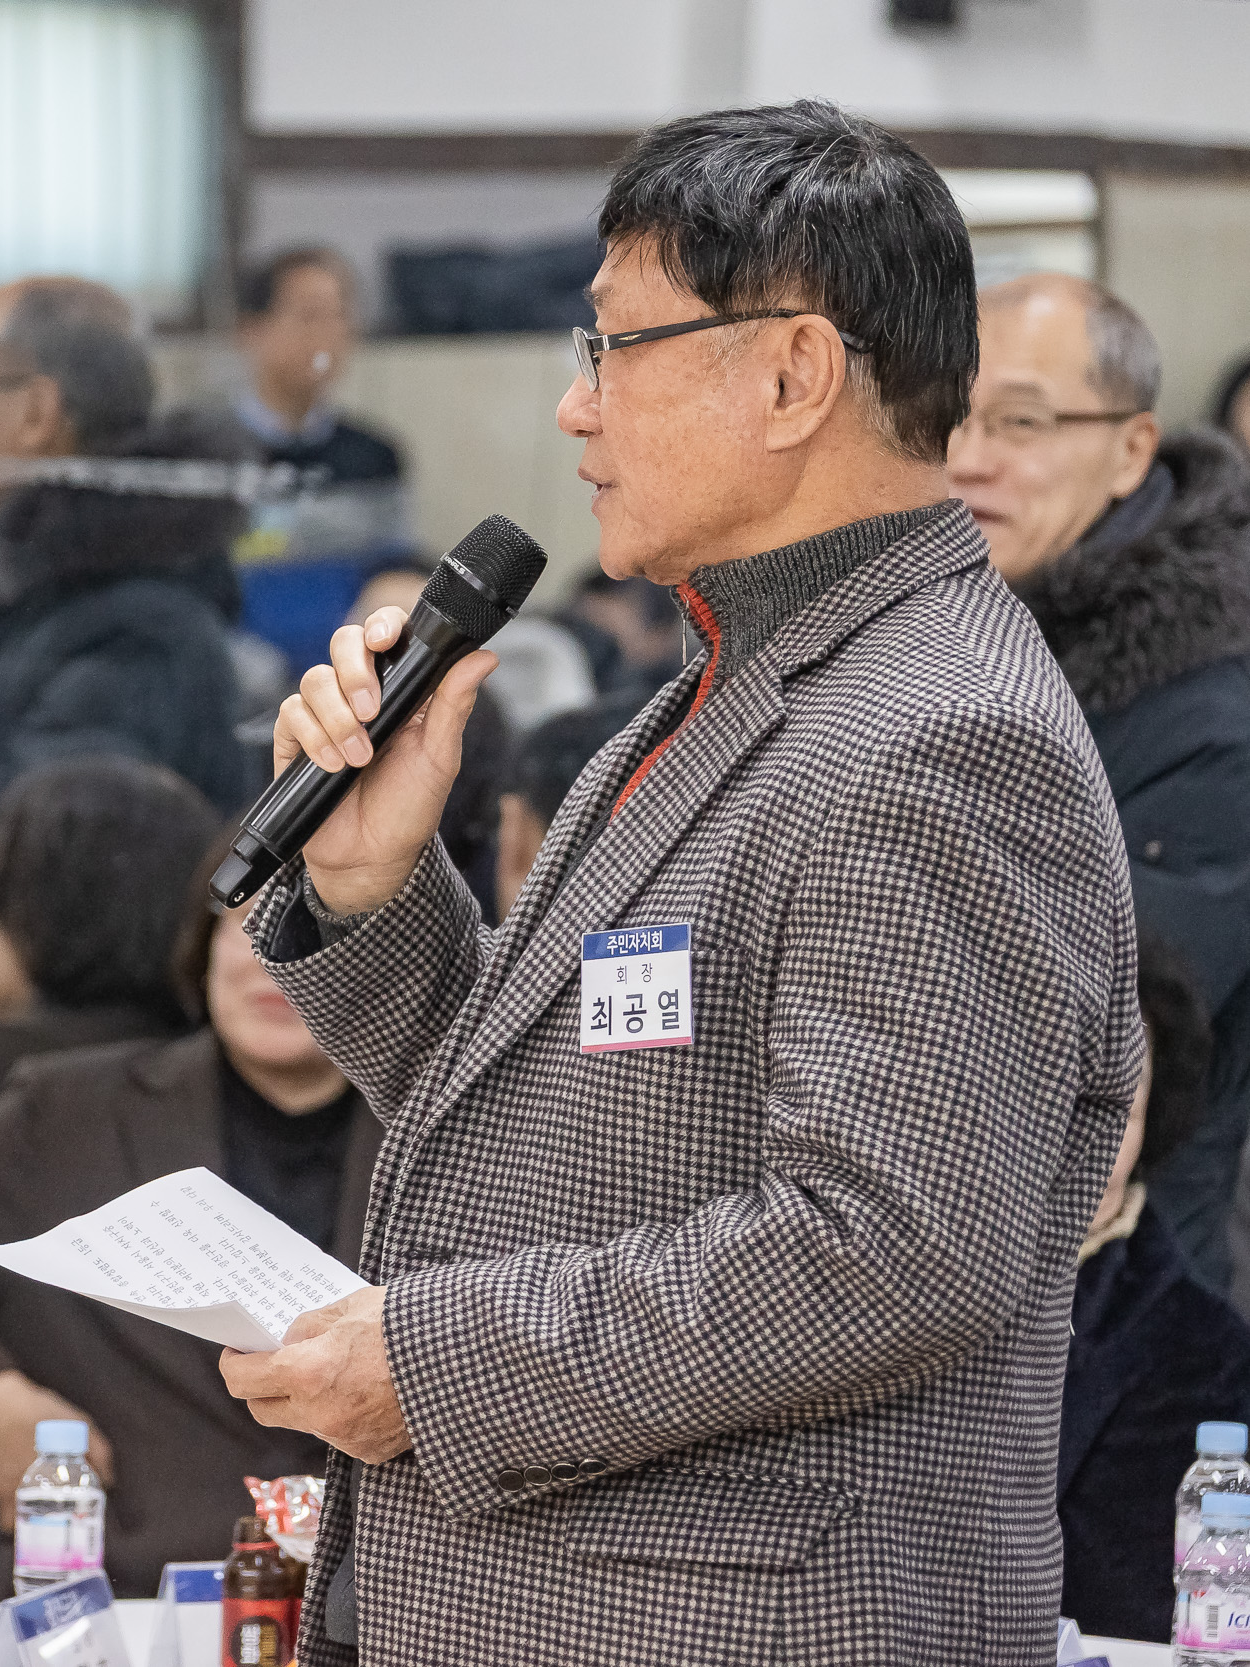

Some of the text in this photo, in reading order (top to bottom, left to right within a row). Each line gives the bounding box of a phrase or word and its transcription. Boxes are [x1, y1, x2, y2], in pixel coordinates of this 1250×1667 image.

[233, 891, 245, 903] 3
[606, 930, 663, 956] 주민자치회
[150, 1200, 160, 1208] 수
[195, 1198, 214, 1212] 우리
[117, 1215, 143, 1236] 노력이
[158, 1208, 184, 1228] 신뢰할
[102, 1225, 132, 1250] 자치구중
[182, 1228, 199, 1243] 더욱
[70, 1237, 93, 1256] 1등급
[198, 1243, 230, 1269] 광진구를
[130, 1249, 155, 1270] 서울시
[163, 1256, 193, 1281] 여러분의
[92, 1257, 129, 1287] 종합청렴도
[153, 1270, 185, 1295] 광진구가
[218, 1236, 307, 1313] 도시라는 자부심을 느낍니다.
[277, 1268, 294, 1283] 직원
[299, 1263, 342, 1296] 부탁드립니다.
[192, 1281, 210, 1298] 직원
[227, 1269, 259, 1298] 주민들이
[293, 1280, 324, 1304] 청장님과
[257, 1295, 276, 1311] 우리
[1227, 1611, 1250, 1629] ICI
